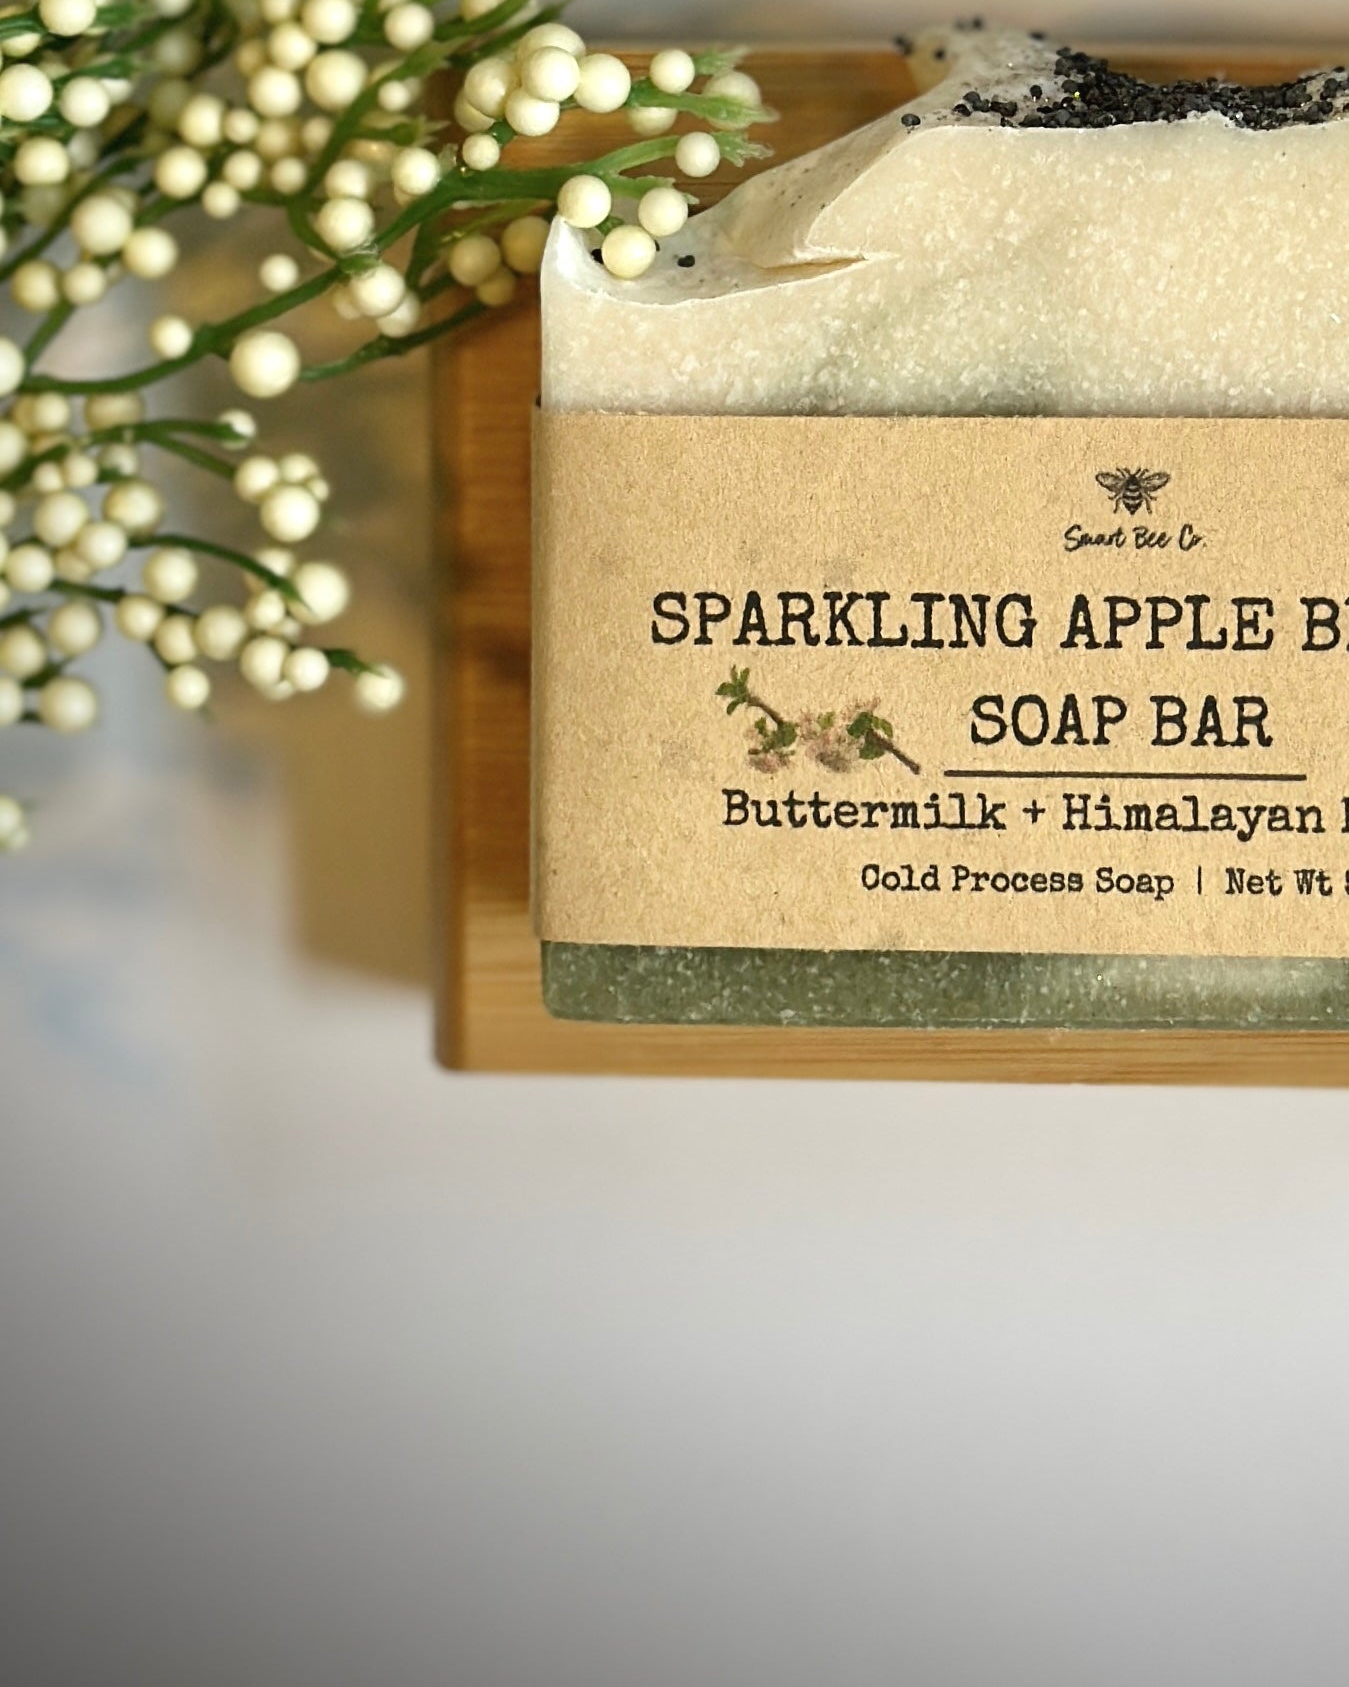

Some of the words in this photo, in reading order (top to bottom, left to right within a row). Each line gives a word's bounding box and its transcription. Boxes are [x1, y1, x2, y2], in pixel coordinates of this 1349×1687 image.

[1064, 523, 1127, 553] Smart
[1132, 525, 1172, 550] Bee
[650, 589, 1038, 650] SPARKLING
[1059, 593, 1274, 651] APPLE
[970, 693, 1128, 747] SOAP
[1149, 694, 1274, 748] BAR
[721, 788, 1007, 831] Buttermilk
[1022, 799, 1046, 824] +
[1062, 792, 1326, 843] Himalayan
[861, 863, 941, 892] Cold
[951, 864, 1084, 893] Process
[1095, 866, 1175, 902] Soap
[1225, 867, 1283, 897] Net
[1293, 868, 1333, 897] Wt
